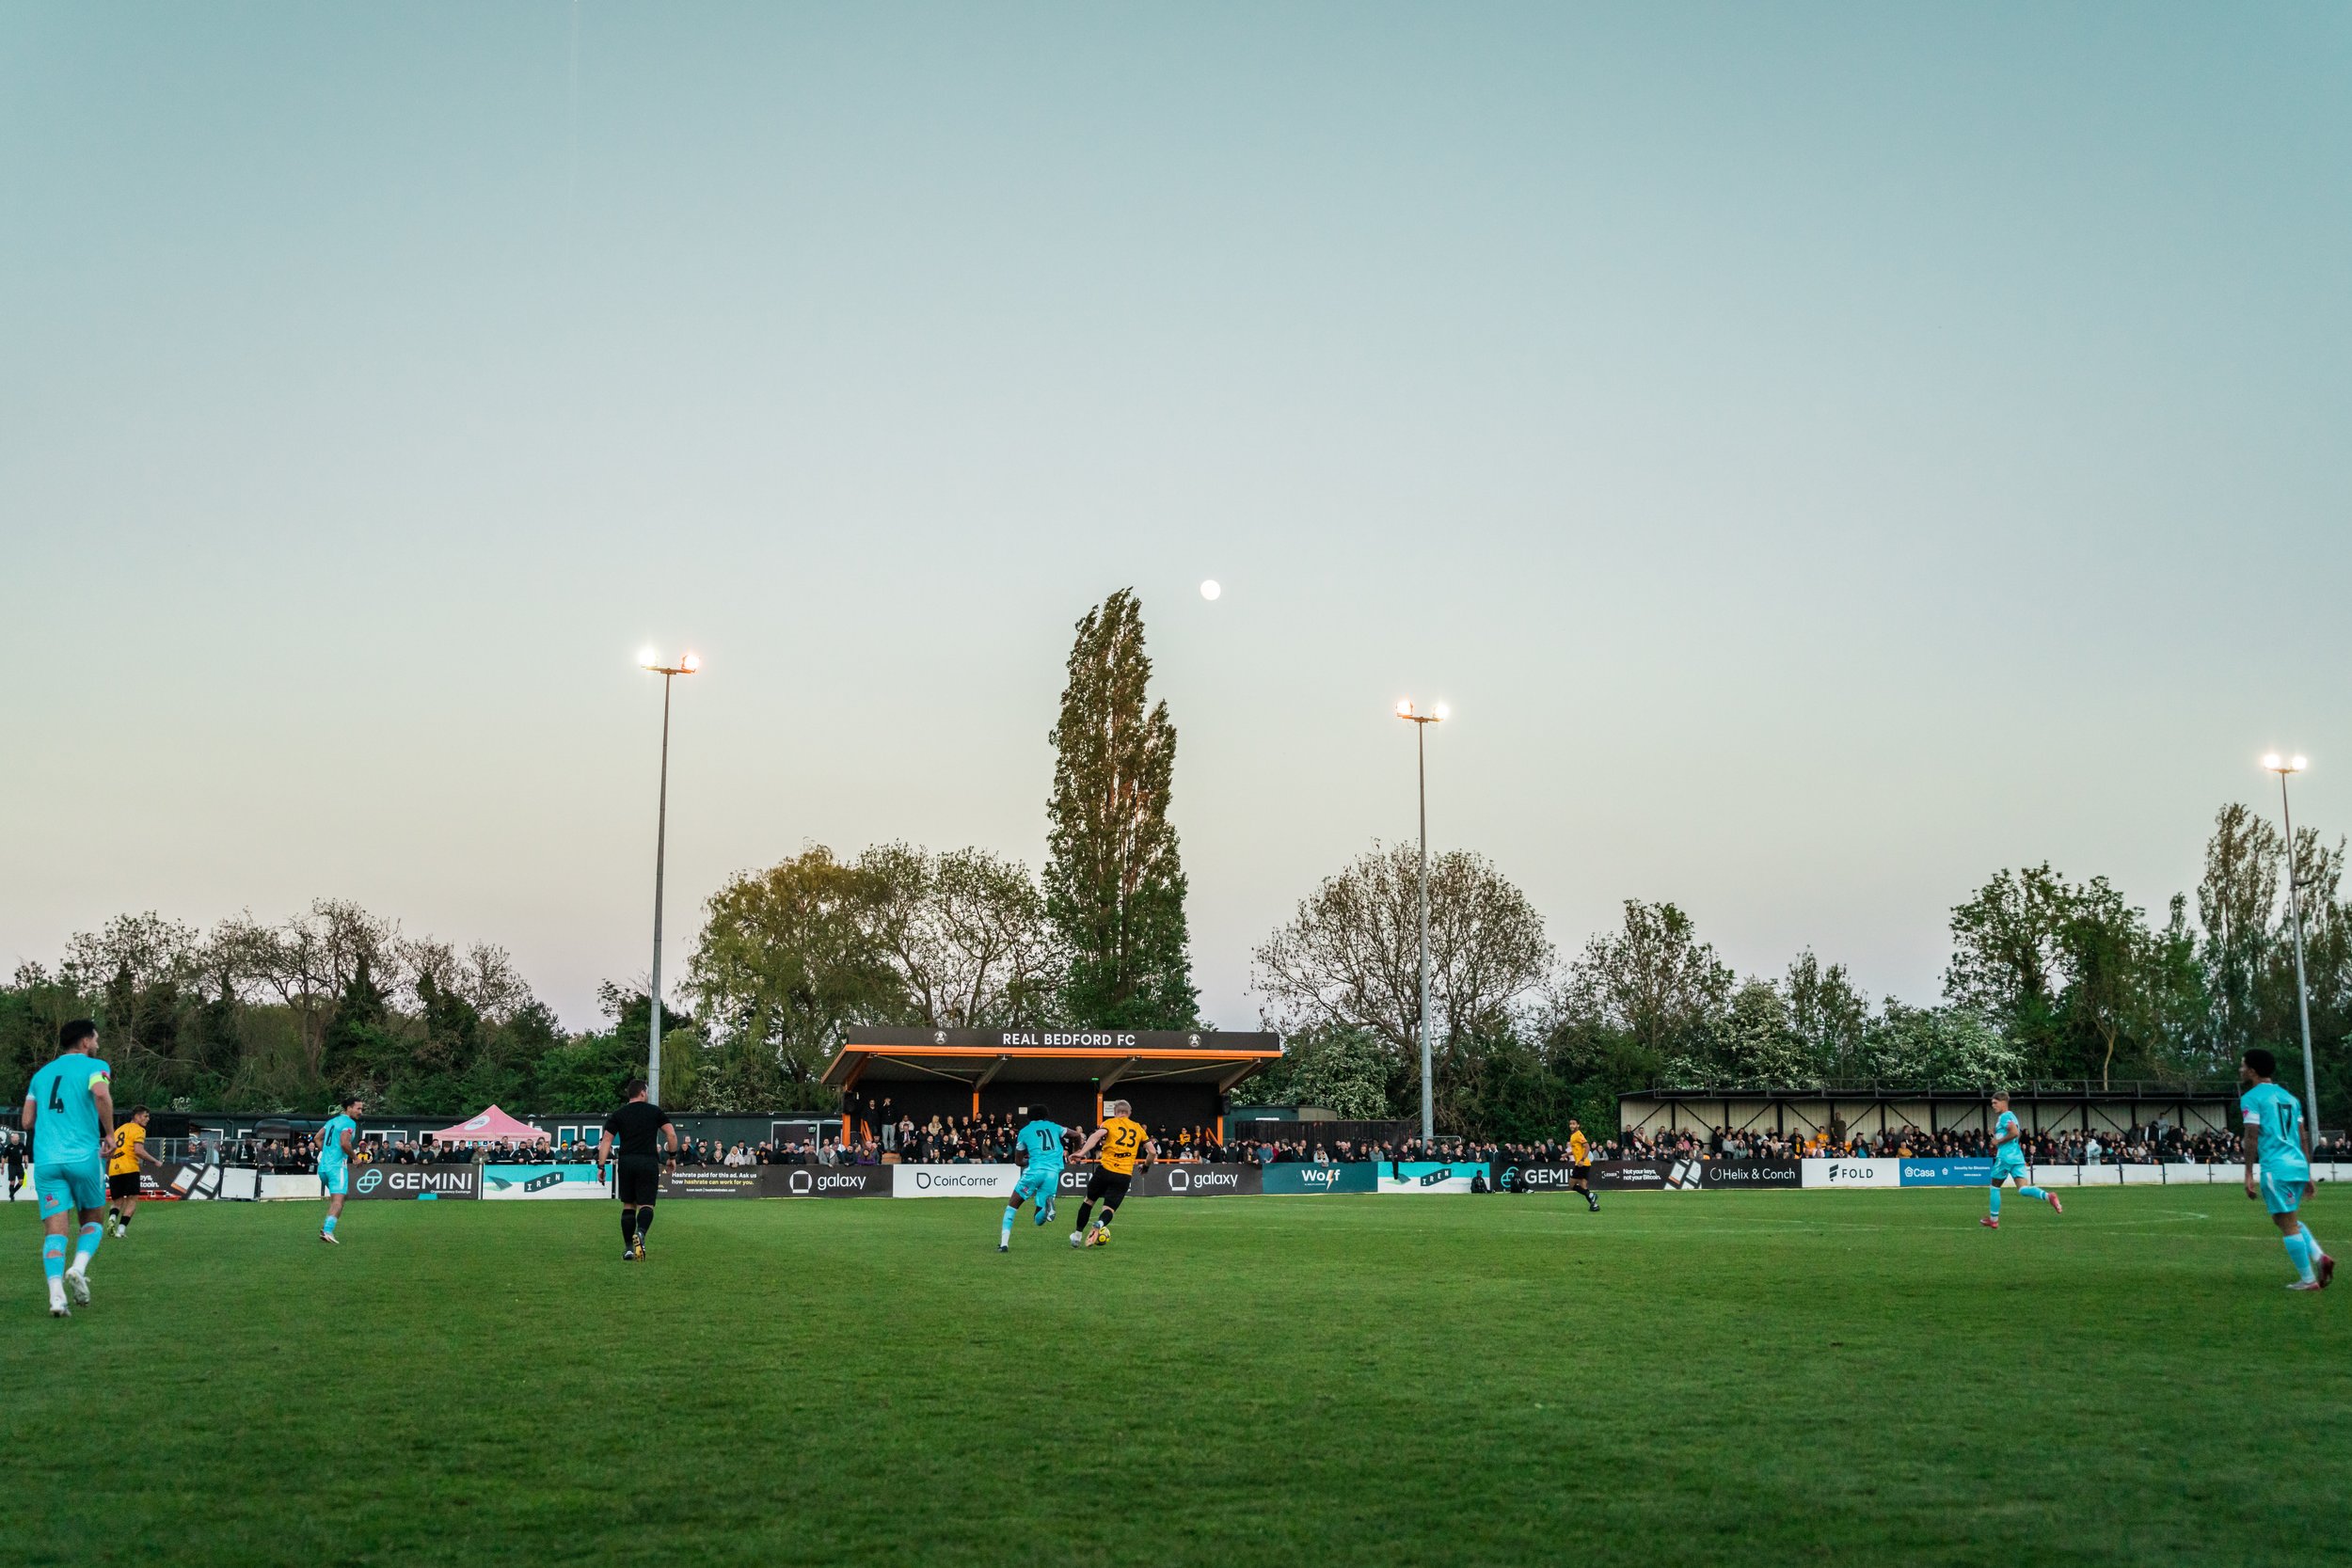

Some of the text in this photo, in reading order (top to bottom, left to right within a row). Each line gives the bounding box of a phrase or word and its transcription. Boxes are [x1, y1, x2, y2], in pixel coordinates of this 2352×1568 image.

[1003, 1033, 1136, 1046] REAL BEDFORD FC
[48, 1075, 65, 1114] 4
[2277, 1102, 2292, 1140] 17
[117, 1132, 125, 1148] 8
[1036, 1129, 1055, 1151] 21
[1115, 1127, 1136, 1148] 23
[933, 1175, 998, 1186] CoinCorner
[1194, 1171, 1238, 1188] galaxy
[1422, 1169, 1449, 1185] IREN
[1524, 1168, 1573, 1184] GEMI
[1723, 1167, 1796, 1180] Helix & Conch
[1841, 1168, 1874, 1179] FOLD
[1914, 1167, 1935, 1178] Casa
[389, 1173, 472, 1190] GEMINI
[527, 1173, 561, 1191] IREN
[818, 1173, 866, 1190] galaxy
